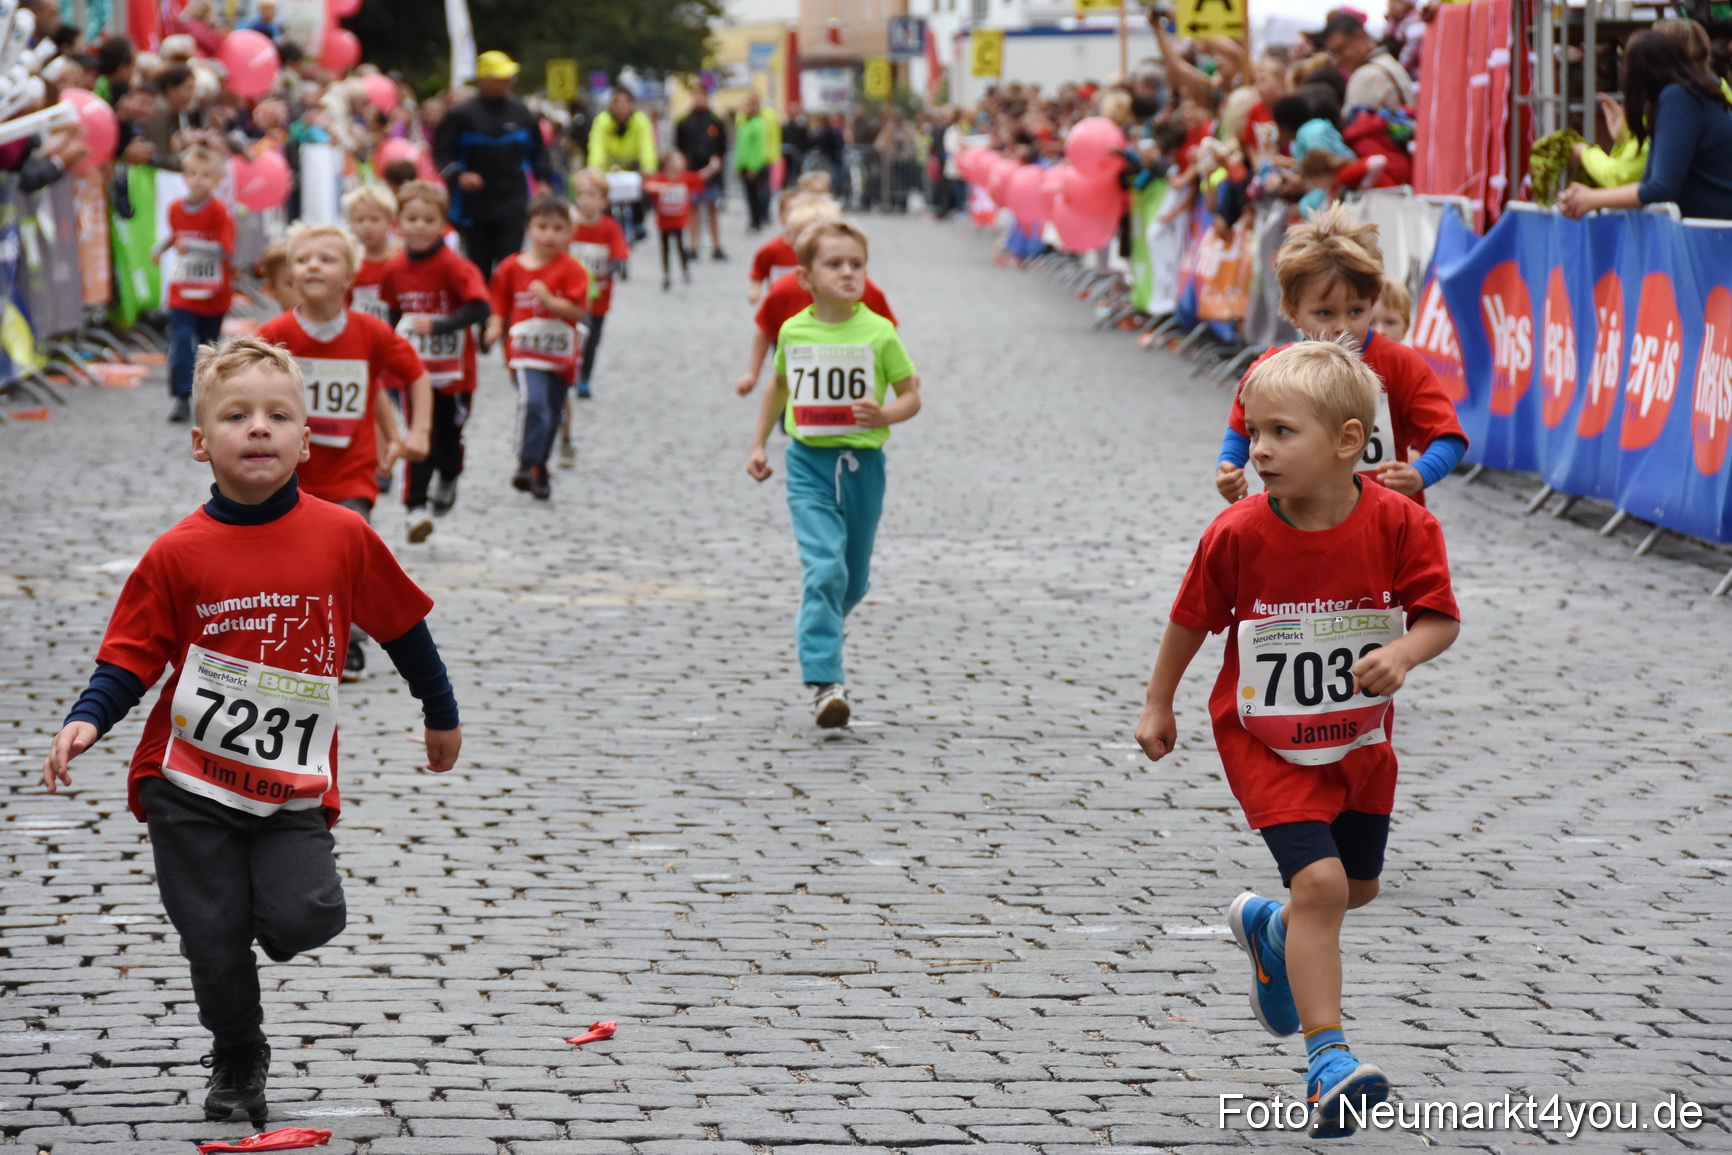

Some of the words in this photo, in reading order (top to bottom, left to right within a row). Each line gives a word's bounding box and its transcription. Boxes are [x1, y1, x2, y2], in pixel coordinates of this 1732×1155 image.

[977, 40, 995, 65] C
[793, 366, 866, 400] 7106
[196, 592, 299, 619] Neumarkter
[1253, 598, 1353, 615] Neumarkter
[1252, 631, 1304, 644] NeuerMarkt
[1313, 614, 1391, 637] BOCK
[198, 664, 248, 687] NeuerMarkt
[257, 671, 331, 701] BOCK
[1245, 704, 1253, 714] 2
[193, 686, 320, 766] 7231
[1291, 718, 1358, 745] Jannis
[200, 755, 237, 787] Tim
[243, 772, 296, 800] Leon
